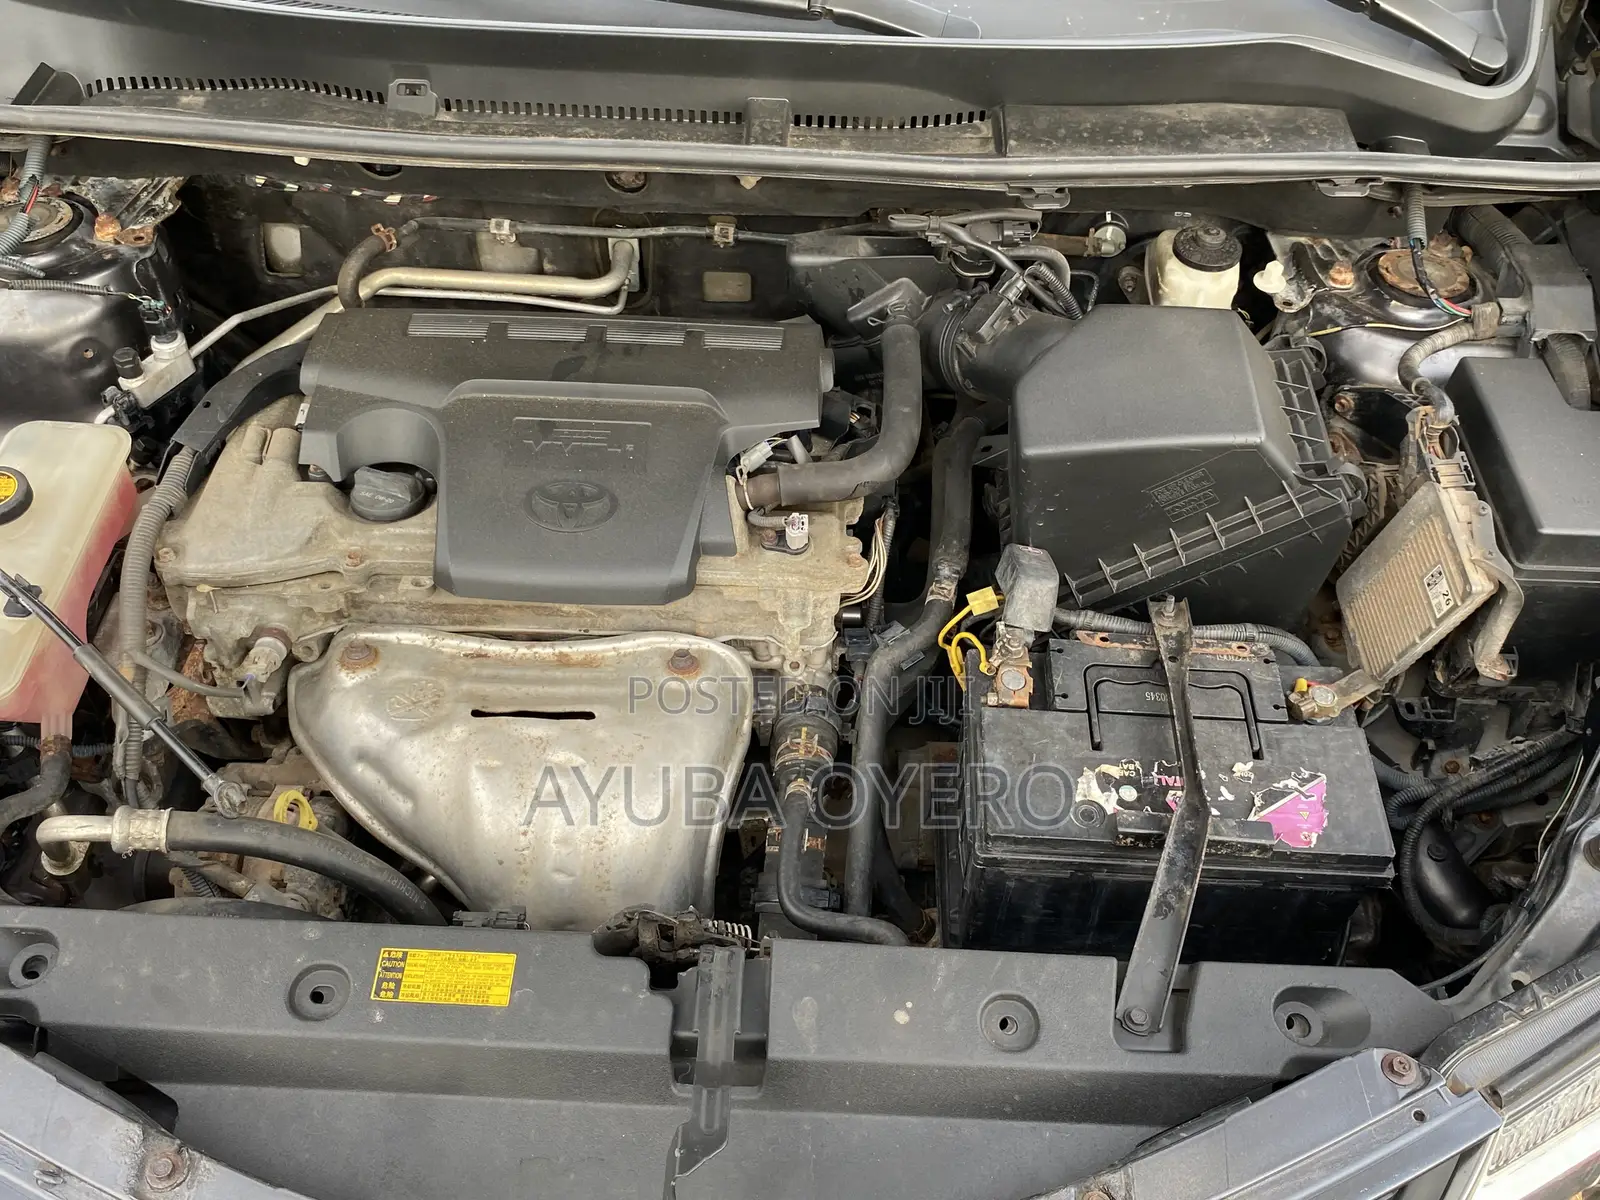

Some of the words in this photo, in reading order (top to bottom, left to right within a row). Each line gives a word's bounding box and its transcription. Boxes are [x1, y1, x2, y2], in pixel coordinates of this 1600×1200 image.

[1145, 691, 1168, 702] 0345
[382, 960, 405, 968] CAUTION
[379, 970, 403, 979] ATTENTION
